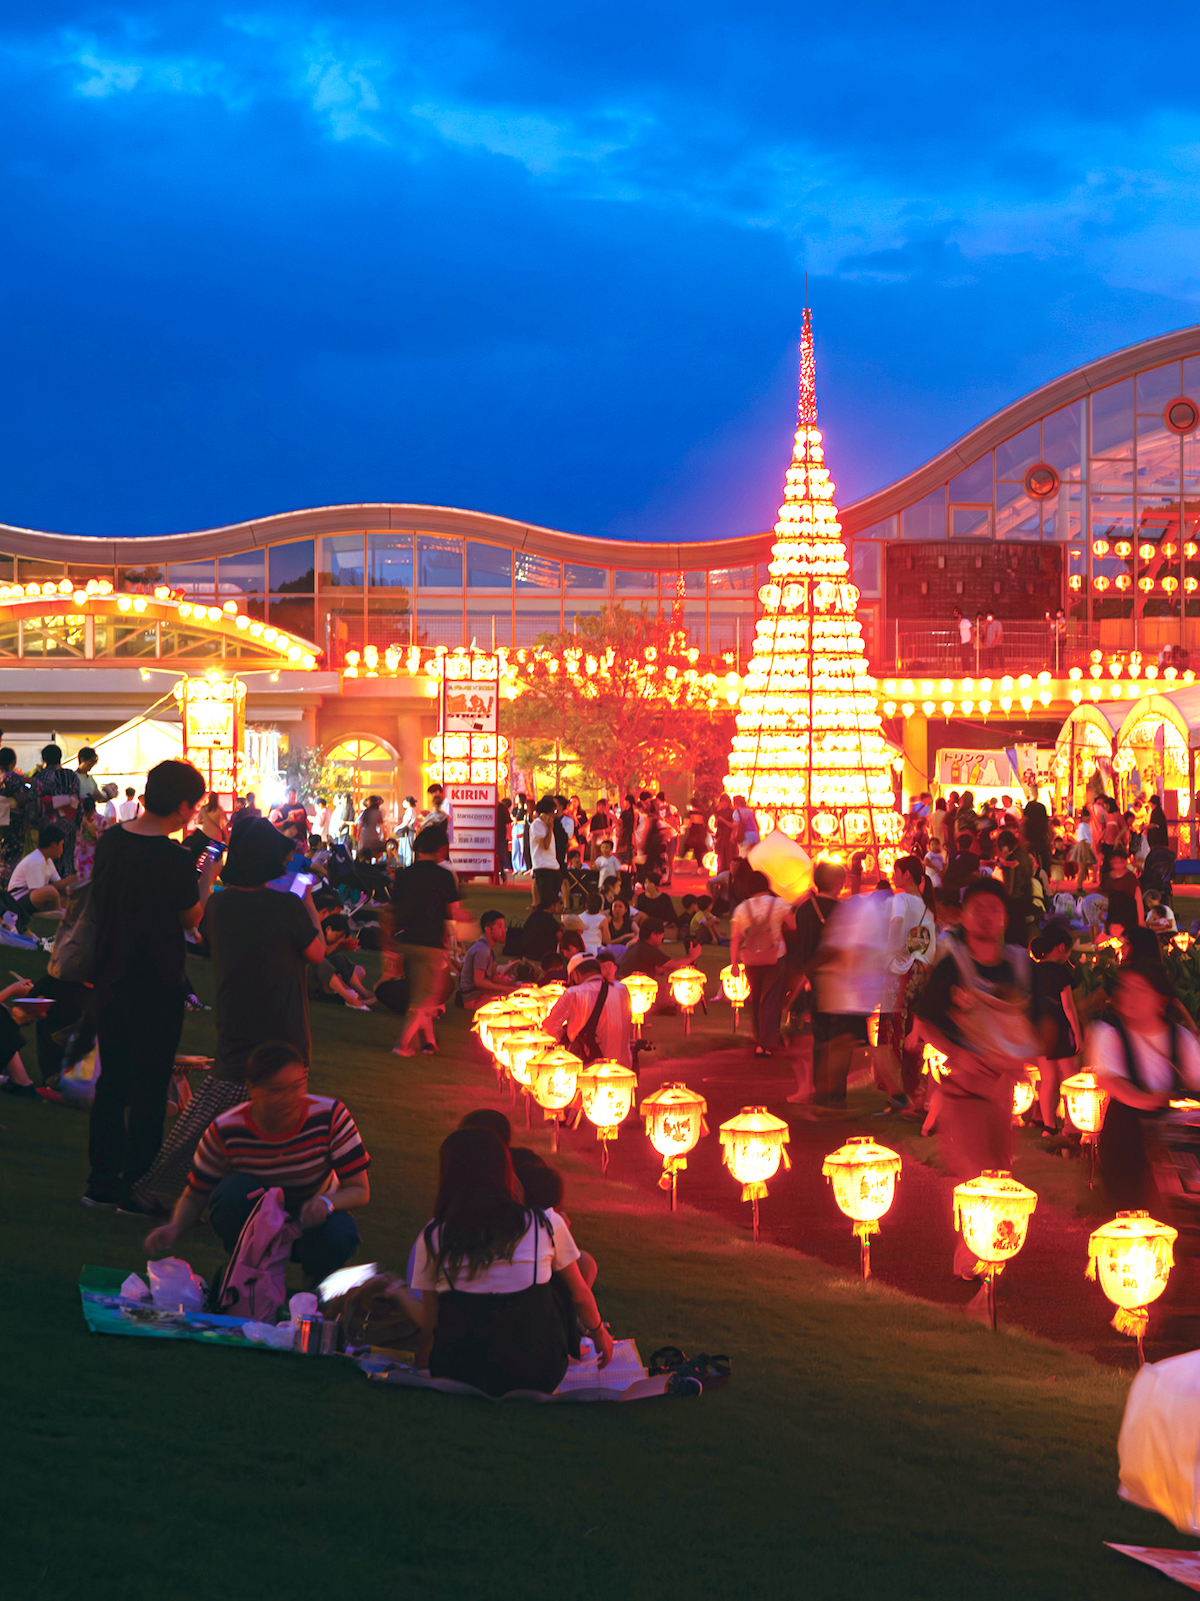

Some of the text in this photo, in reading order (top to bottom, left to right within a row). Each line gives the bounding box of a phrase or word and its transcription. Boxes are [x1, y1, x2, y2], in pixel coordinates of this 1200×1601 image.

[944, 752, 985, 763] ドリンク
[451, 790, 488, 800] KIRIN
